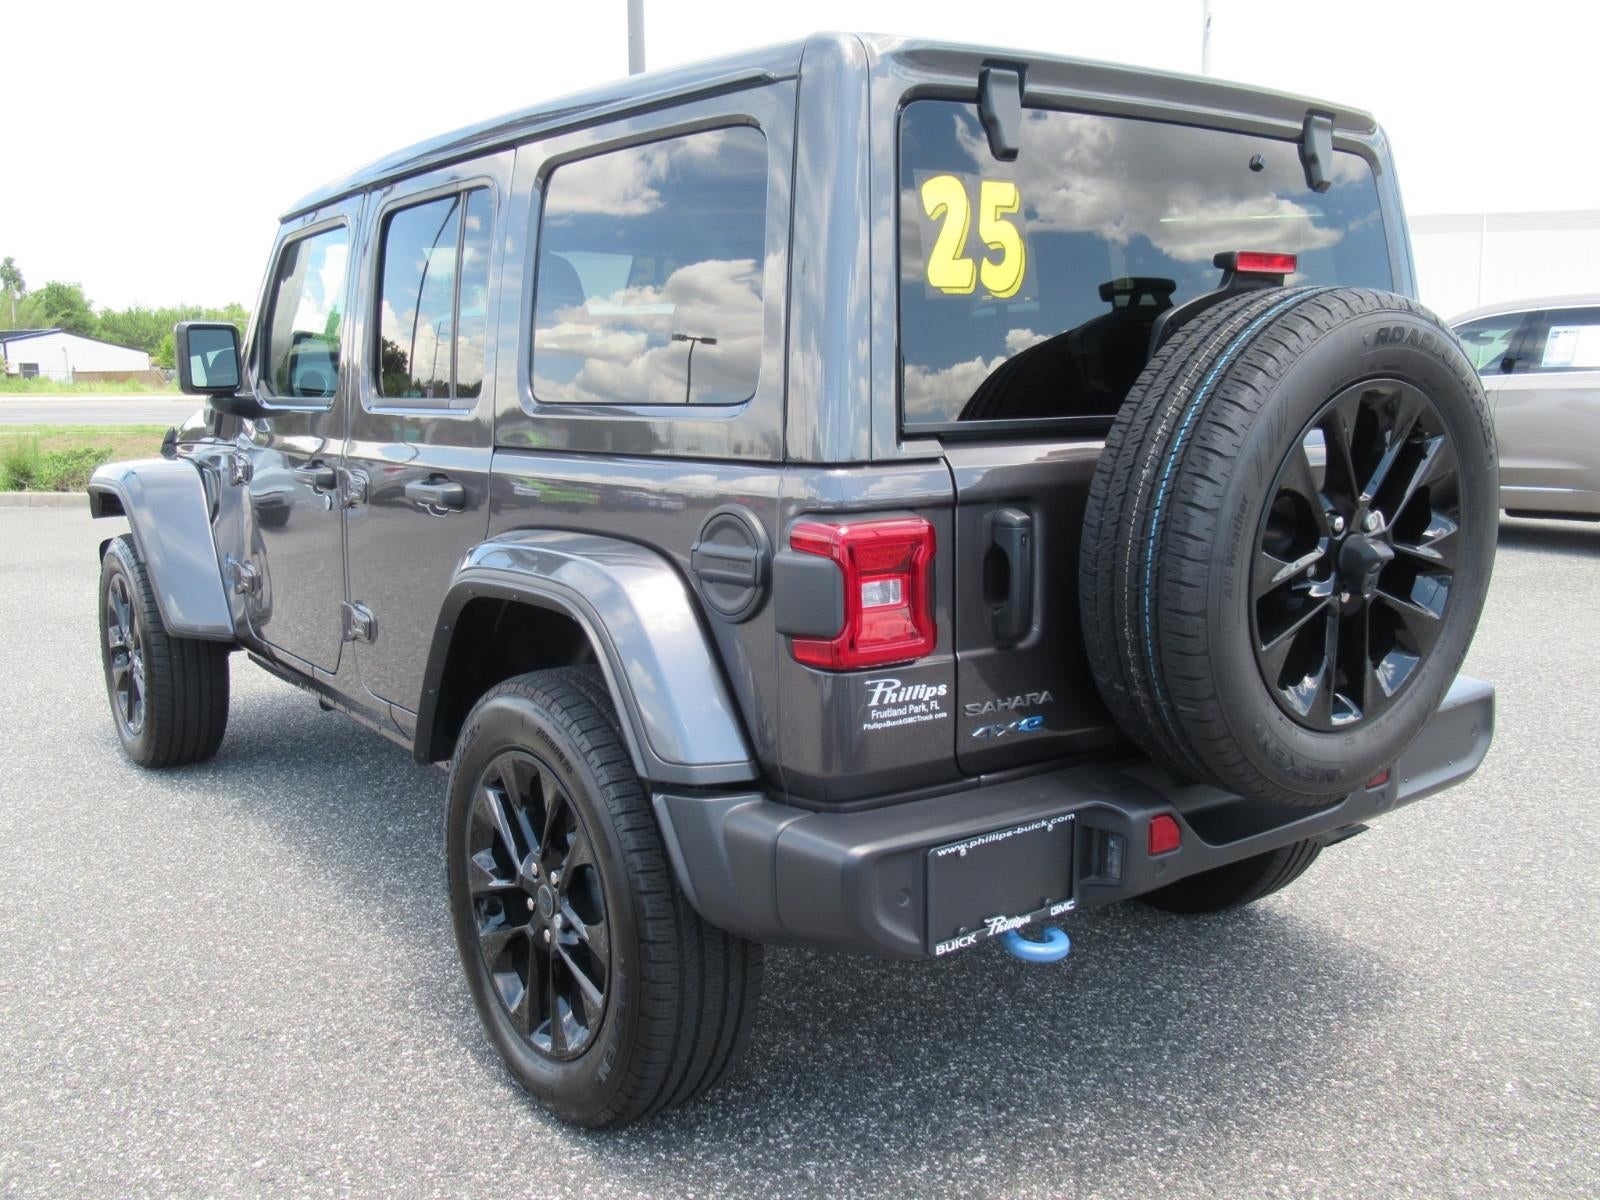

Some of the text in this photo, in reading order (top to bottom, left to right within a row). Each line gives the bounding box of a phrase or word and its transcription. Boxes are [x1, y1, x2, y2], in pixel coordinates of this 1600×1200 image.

[921, 174, 1026, 298] 25
[864, 678, 947, 707] Phillips
[871, 700, 941, 720] Fruitland Park, FL
[963, 690, 1055, 717] SAHARA
[937, 812, 1076, 857] www.phillips-buick.com
[935, 900, 1076, 956] BUICK Phillips GMC
